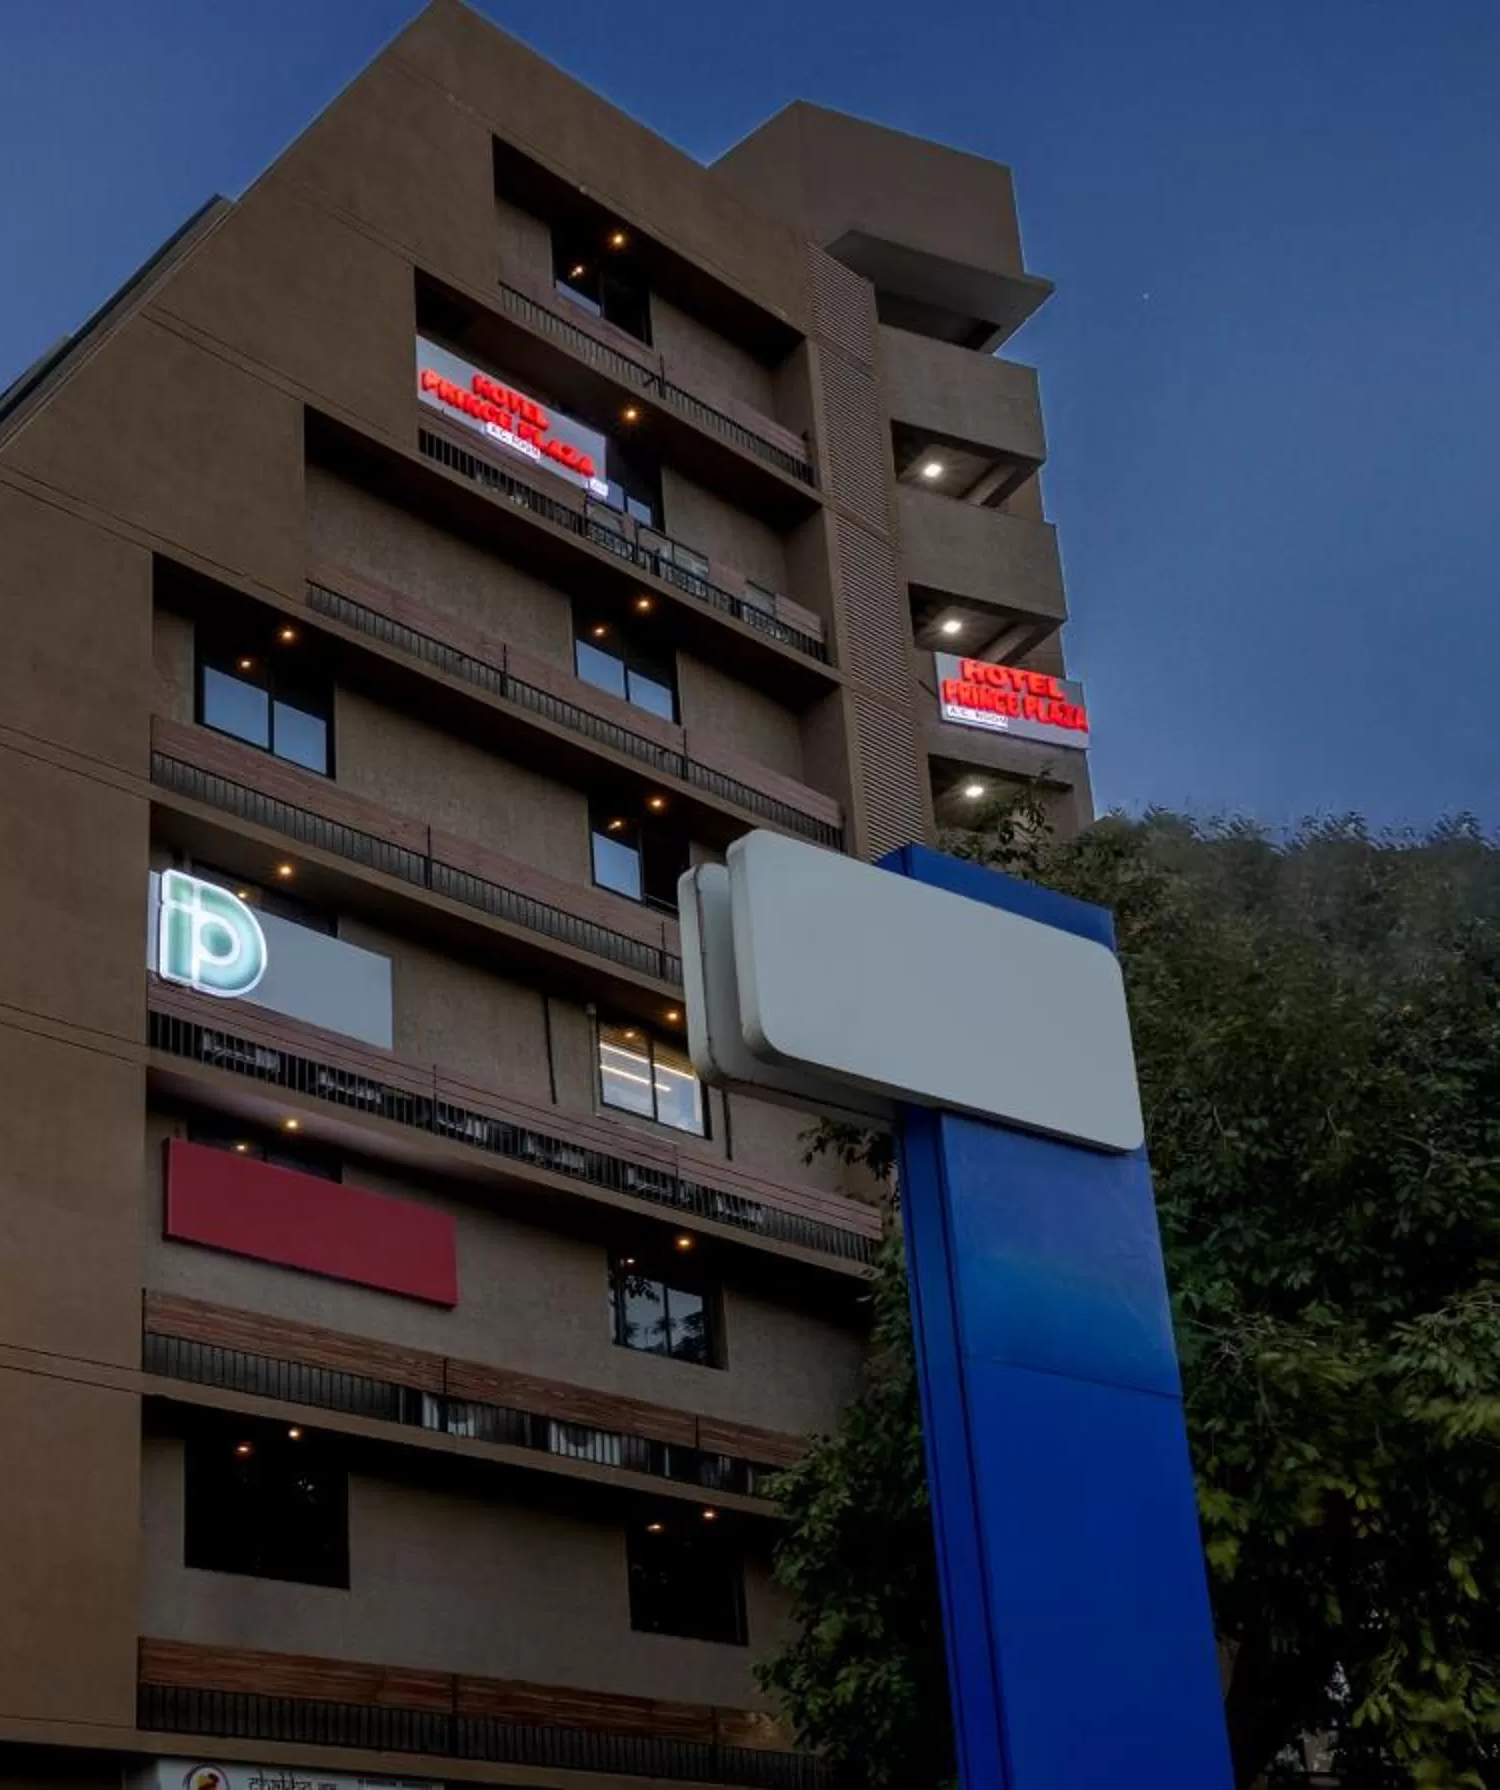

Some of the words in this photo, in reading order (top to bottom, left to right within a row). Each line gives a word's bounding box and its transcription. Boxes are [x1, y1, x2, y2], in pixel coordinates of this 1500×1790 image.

[422, 370, 512, 430] PRINCE
[518, 421, 595, 477] PLAZA
[473, 374, 549, 430] HOTEL
[943, 680, 1018, 716] PRINCE
[1024, 696, 1088, 732] PLAZA
[962, 660, 1066, 700] HOTEL
